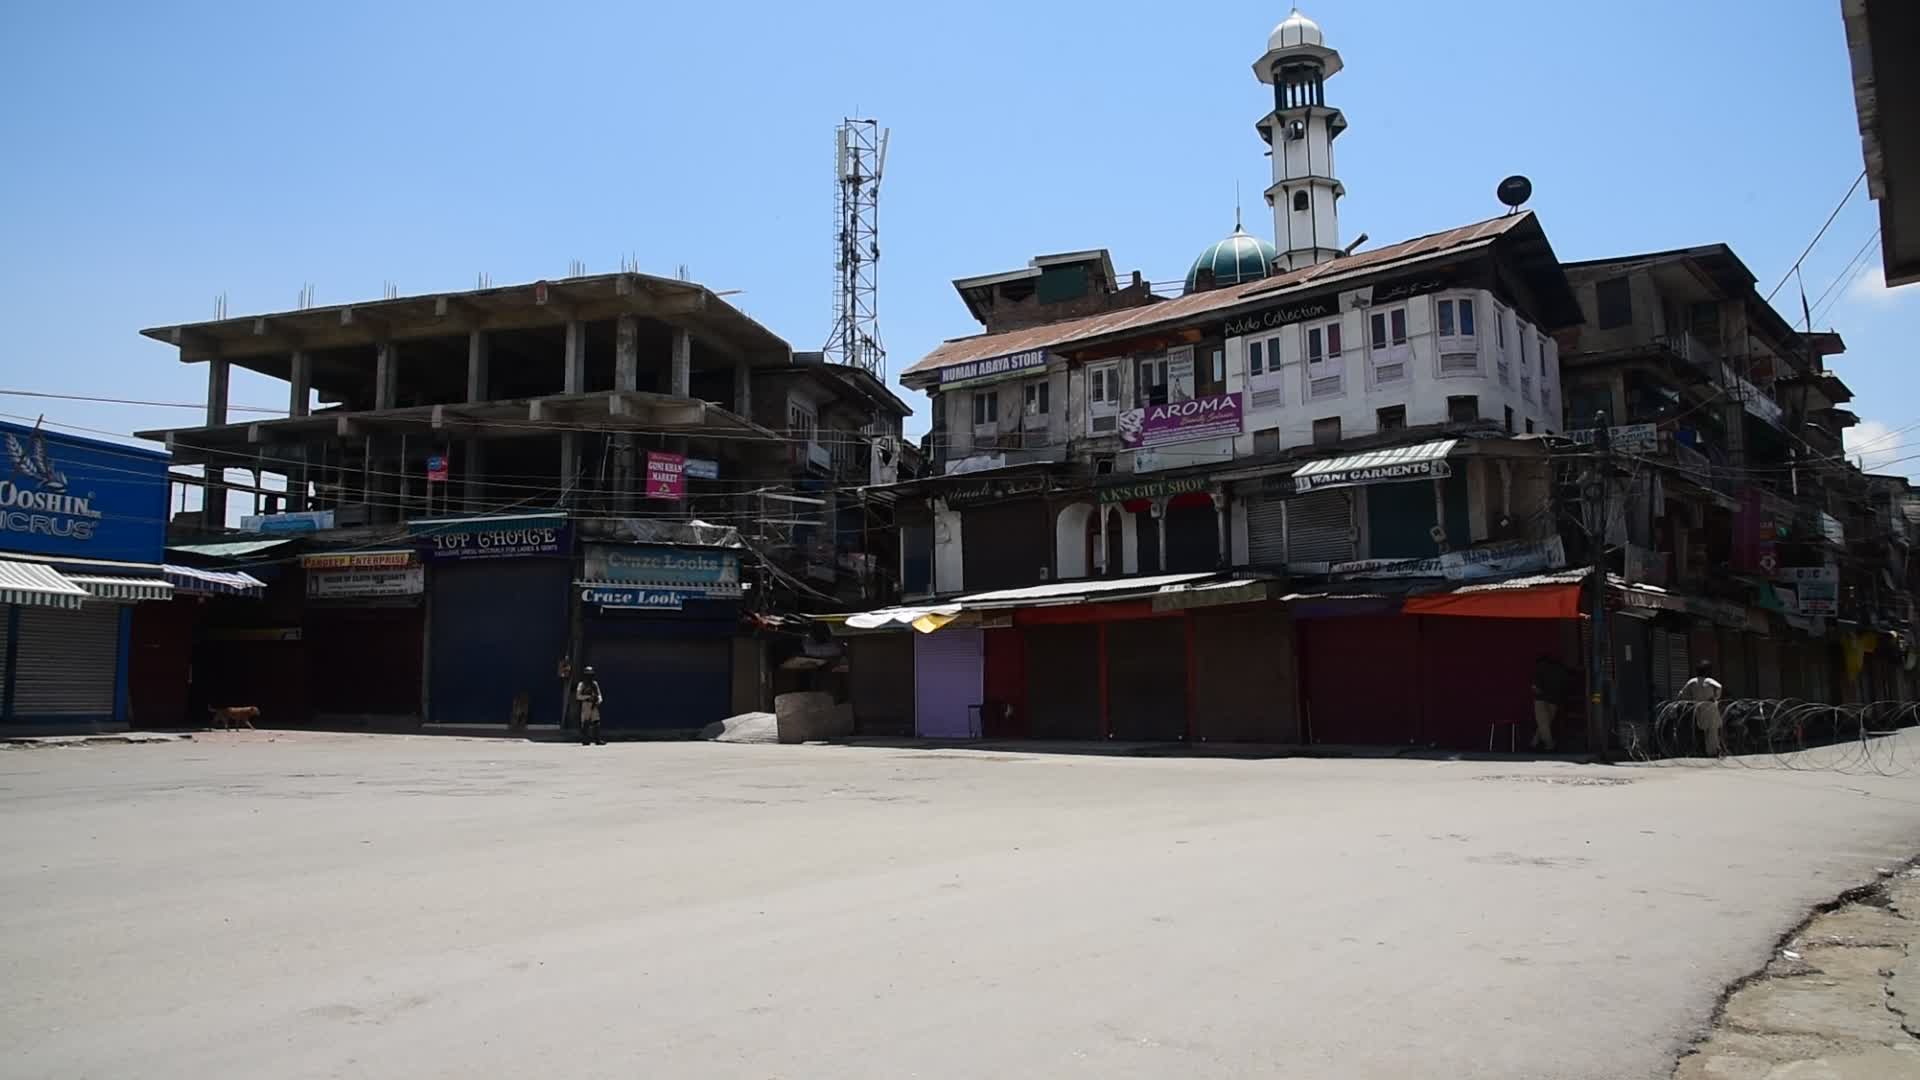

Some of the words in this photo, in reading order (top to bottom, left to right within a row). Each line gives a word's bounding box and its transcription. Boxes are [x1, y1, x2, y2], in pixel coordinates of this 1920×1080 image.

[1264, 303, 1327, 327] Collection
[978, 356, 1010, 375] ABAYA
[1011, 350, 1044, 369] STORE
[1151, 395, 1237, 421] AROMA
[652, 472, 678, 483] MARKET
[1311, 473, 1347, 485] WANI
[1350, 463, 1430, 480] GARMENTS
[1134, 483, 1164, 496] GIFT
[432, 532, 471, 549] TOP
[478, 528, 557, 548] CHOICE
[663, 554, 720, 571] Looks
[581, 588, 632, 604] Craze
